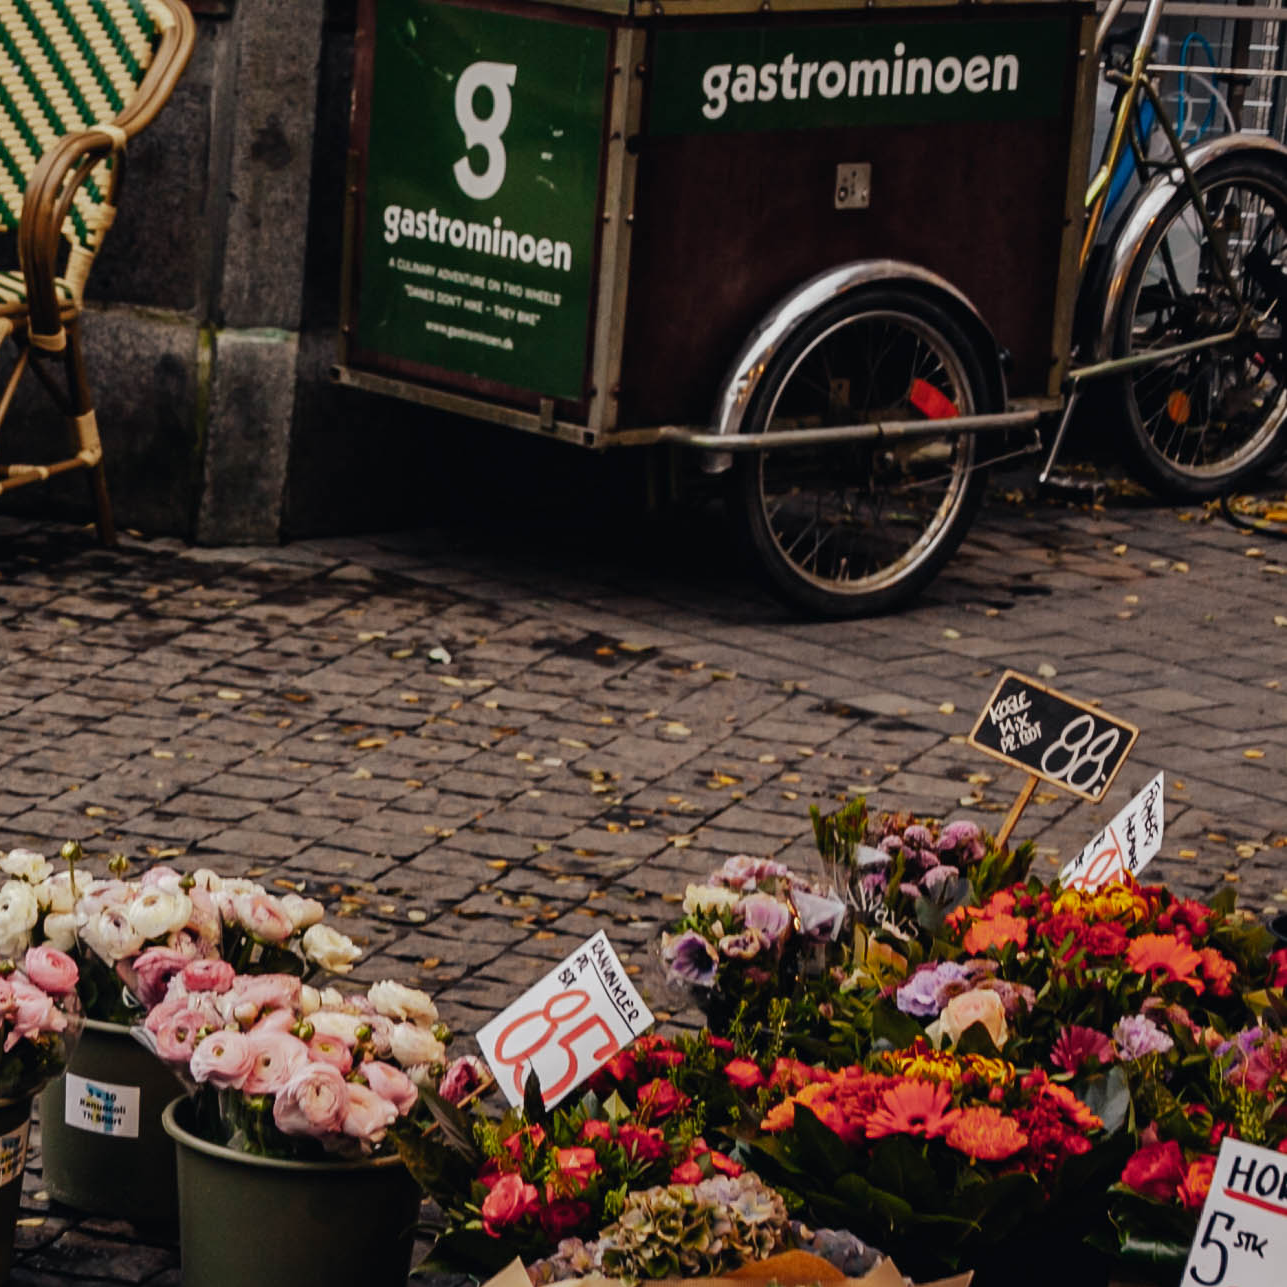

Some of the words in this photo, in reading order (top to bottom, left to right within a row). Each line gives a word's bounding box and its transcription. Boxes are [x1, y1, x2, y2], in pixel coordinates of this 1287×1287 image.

[700, 42, 1021, 121] gastrominoen
[383, 204, 573, 272] gastrominoen
[437, 267, 486, 290] ADVENTURE
[503, 281, 523, 298] TWO
[494, 989, 620, 1103] 85
[1190, 1210, 1235, 1287] 5
